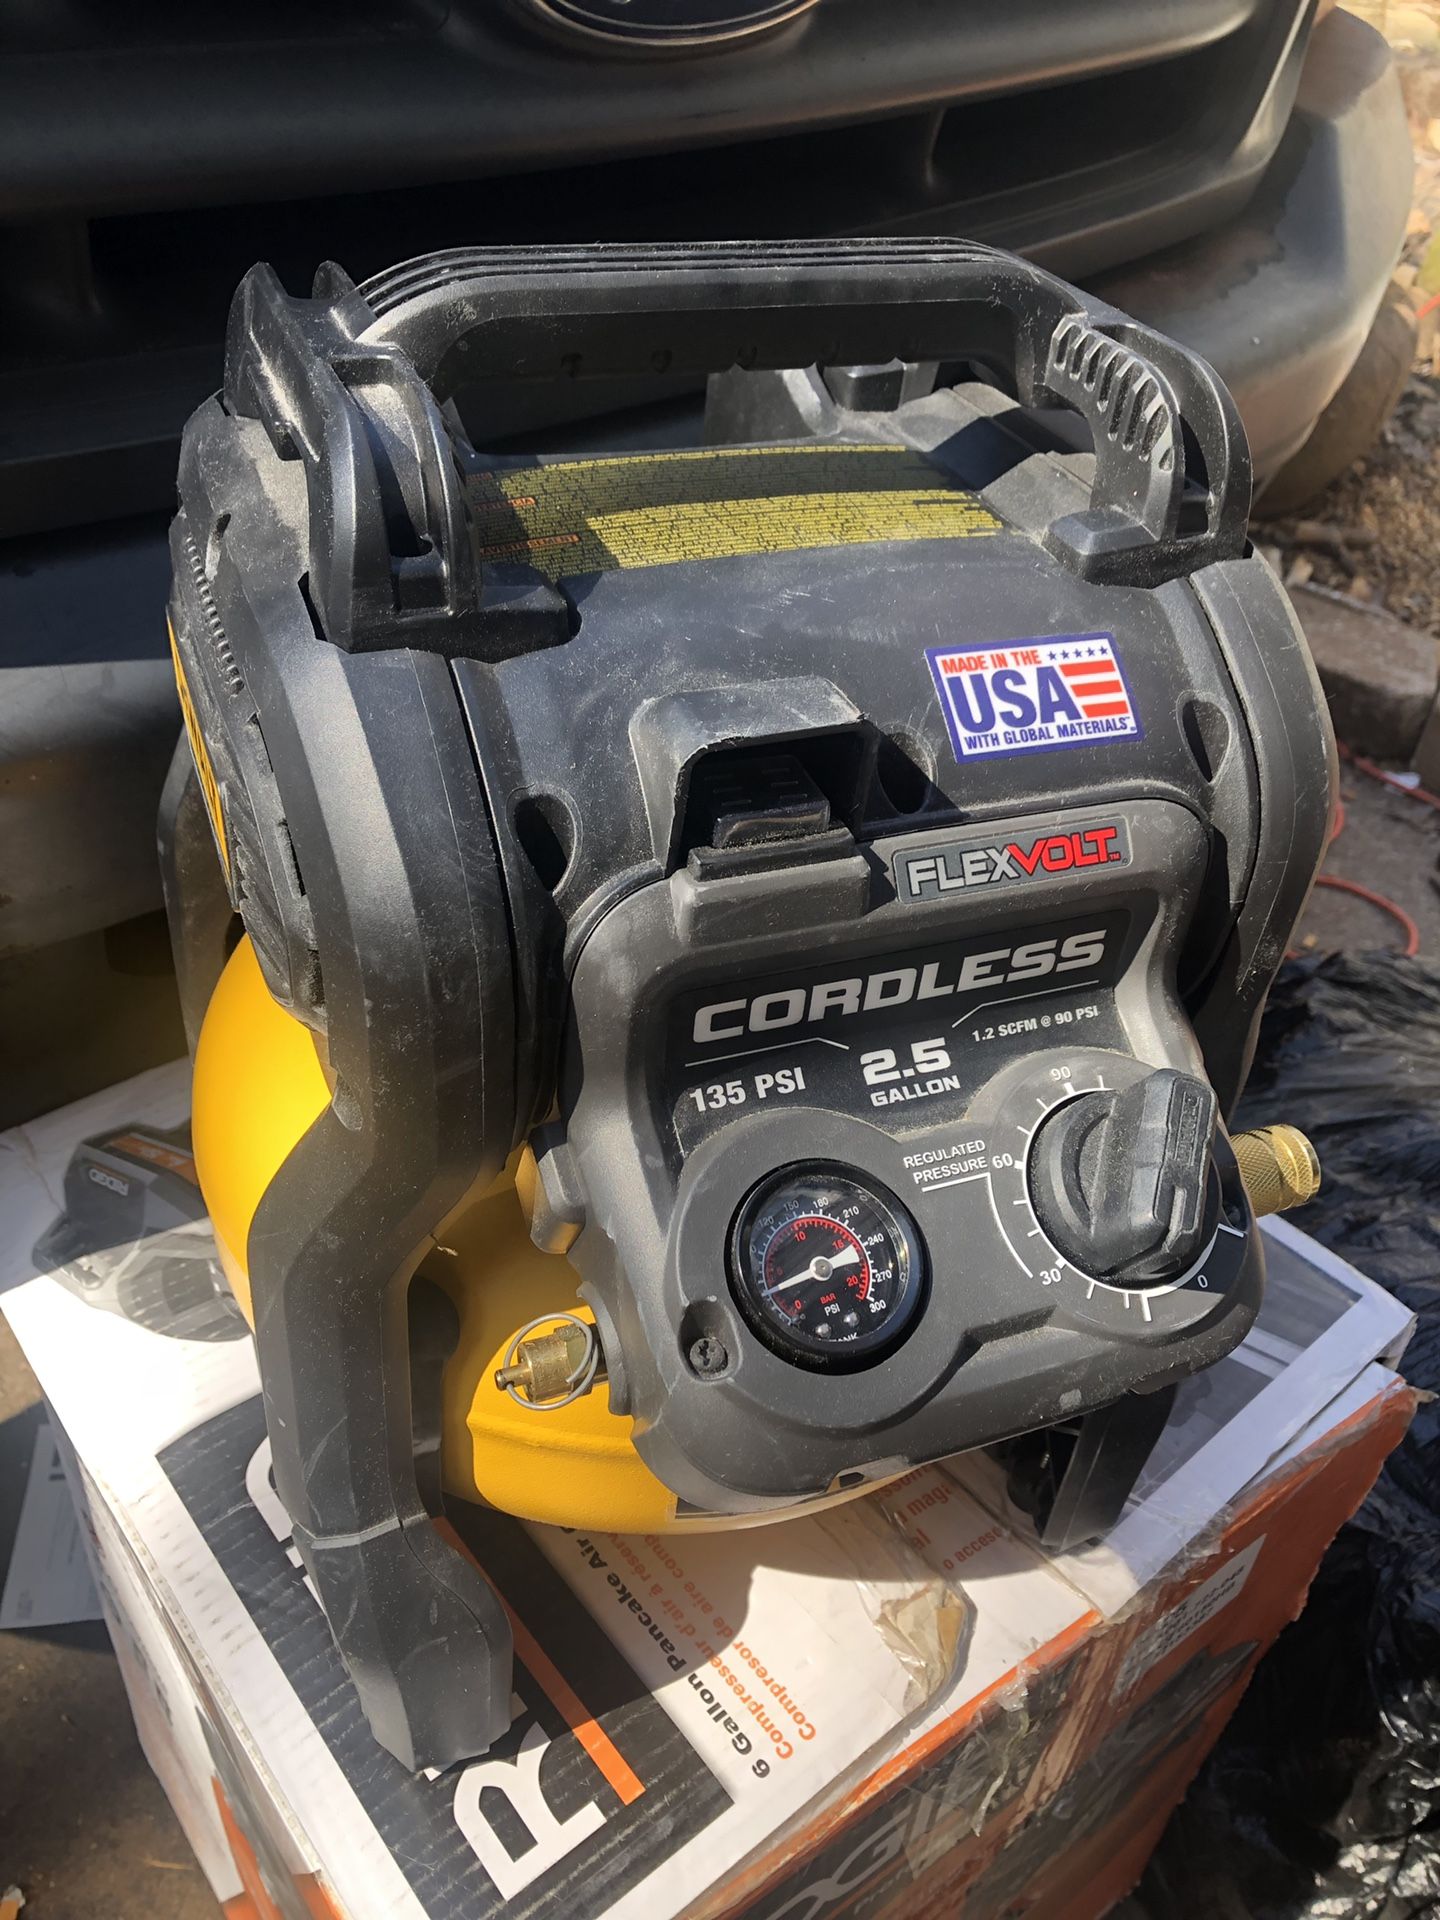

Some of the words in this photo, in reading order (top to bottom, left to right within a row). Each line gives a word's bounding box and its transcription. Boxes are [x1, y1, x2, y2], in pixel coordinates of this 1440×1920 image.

[941, 656, 988, 674] MADE
[991, 653, 1008, 669] IN
[1013, 650, 1042, 666] THE
[946, 665, 1082, 734] USA
[964, 732, 1000, 750] WITH
[1004, 727, 1054, 745] GLOBAL
[692, 929, 1107, 1044] CORDLESS
[972, 1027, 995, 1042] 1.2
[998, 1017, 1038, 1037] SCFM
[1041, 1015, 1053, 1029] @
[1054, 1010, 1073, 1026] 90
[1076, 1005, 1099, 1020] PSI
[860, 1037, 952, 1086] 2.5
[1050, 1066, 1072, 1082] 90
[689, 1079, 747, 1112] 135
[756, 1066, 806, 1099] PSI
[870, 1075, 960, 1107] GALLON
[903, 1139, 986, 1169] REGULATED
[992, 1153, 1014, 1169] 60
[913, 1157, 988, 1185] PRESSURE
[783, 1200, 800, 1212] 150
[813, 1197, 829, 1209] 180
[843, 1206, 860, 1219] 210
[794, 1231, 806, 1242] 10
[867, 1233, 884, 1246] 240
[846, 1276, 859, 1287] 20
[875, 1270, 892, 1283] 270
[1039, 1266, 1063, 1285] 30
[1197, 1274, 1209, 1289] 0
[794, 1300, 802, 1310] 0
[820, 1293, 837, 1305] BAR
[869, 1300, 886, 1313] 300
[824, 1304, 841, 1316] PSI
[576, 1539, 608, 1569] Air
[683, 1582, 713, 1614] aire
[607, 1572, 687, 1672] Pancake
[713, 1617, 735, 1638] de
[695, 1640, 794, 1759] Compresseur
[732, 1641, 816, 1741] Compresor
[687, 1673, 753, 1755] Gallon
[752, 1759, 770, 1778] 6
